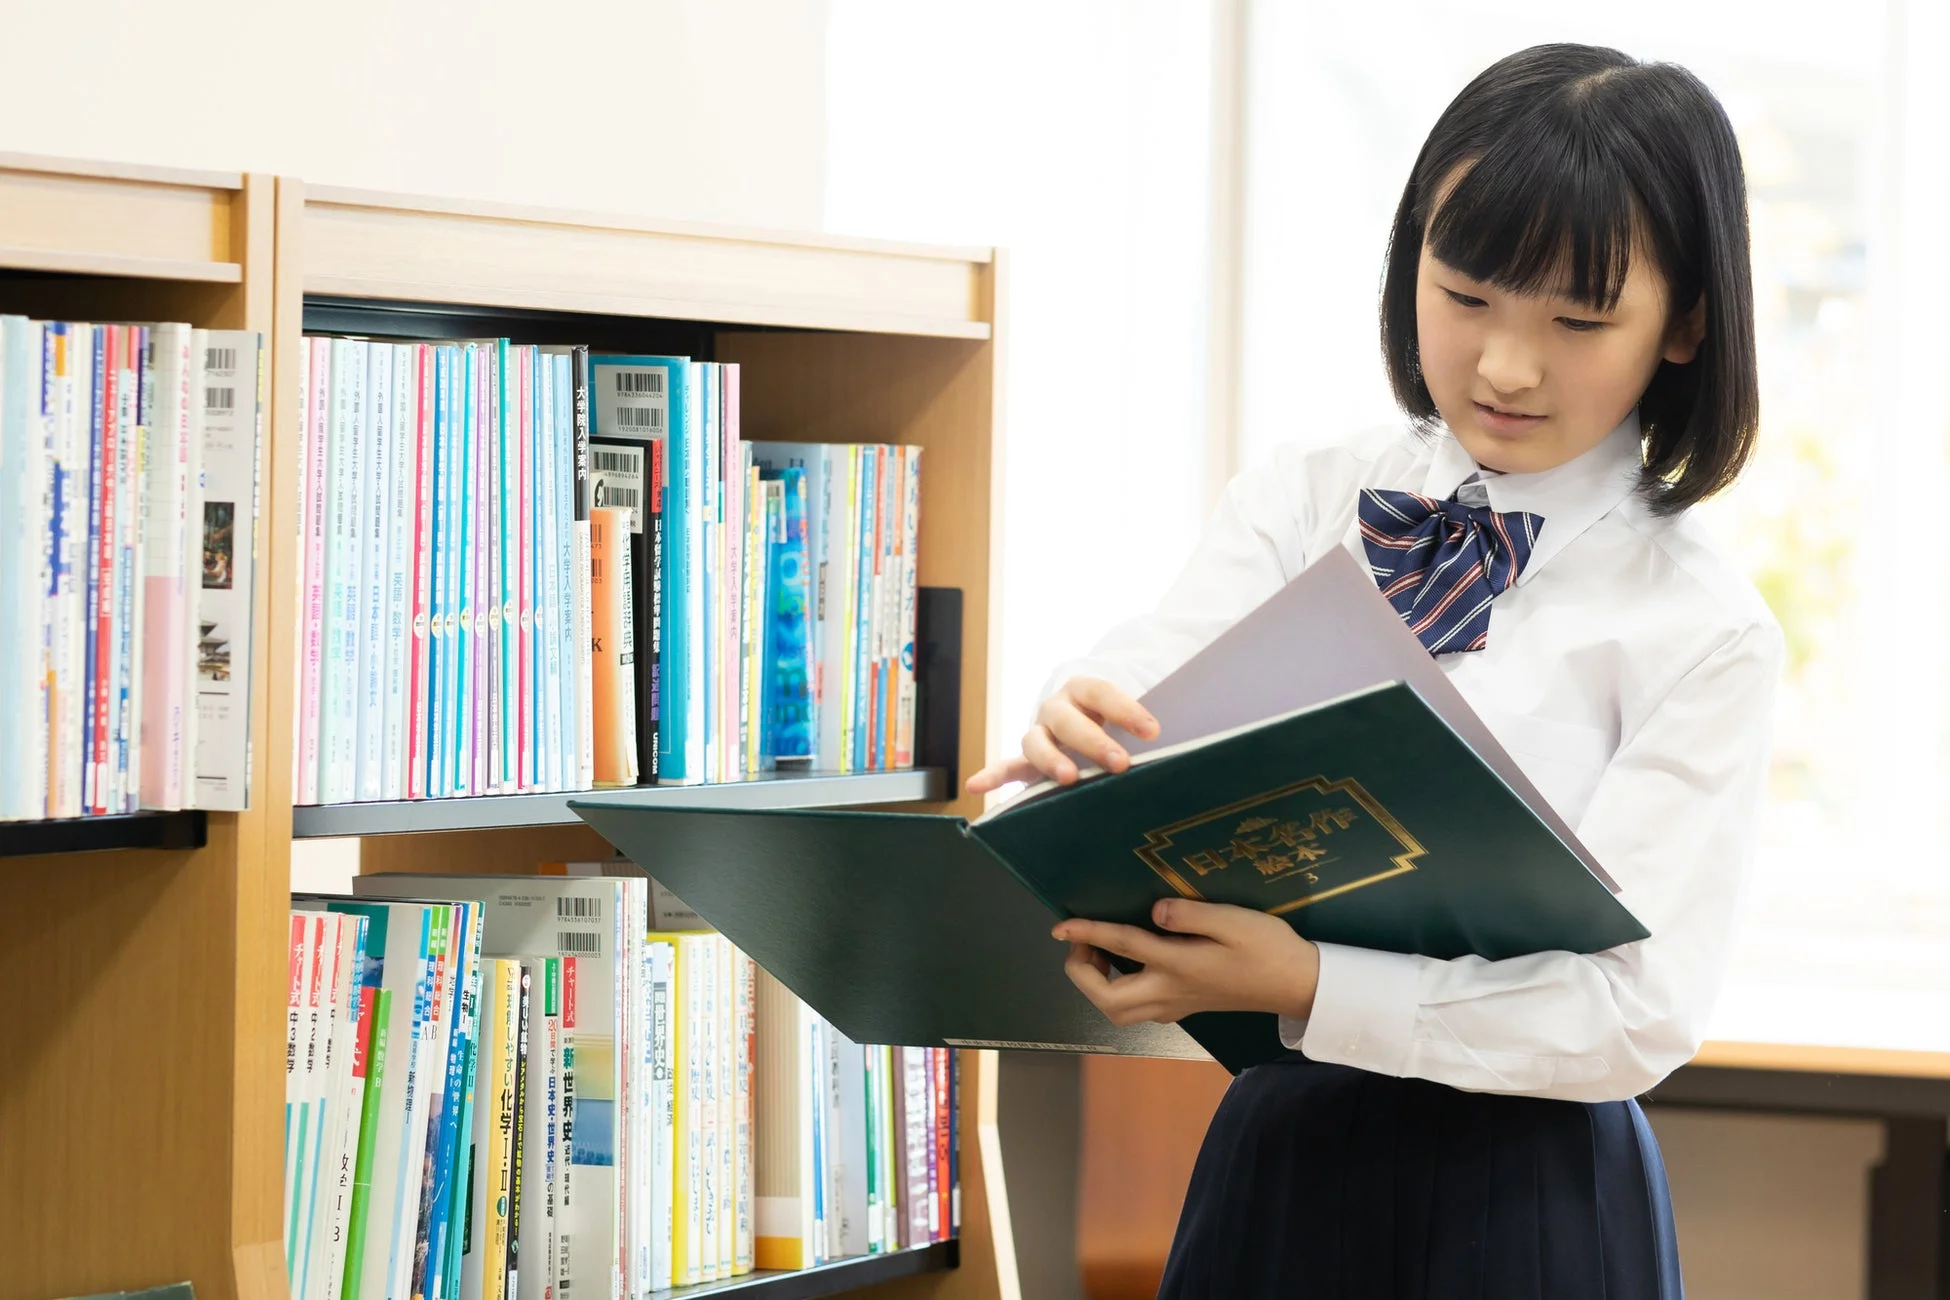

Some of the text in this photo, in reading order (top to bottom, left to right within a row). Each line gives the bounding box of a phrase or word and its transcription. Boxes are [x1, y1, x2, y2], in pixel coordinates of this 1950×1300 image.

[576, 386, 588, 481] 大学院入学案内
[651, 732, 659, 775] UNICOM
[1182, 808, 1359, 876] 日本名作
[1253, 842, 1328, 876] 絵本
[1304, 872, 1319, 884] 3
[423, 961, 436, 1017] 理科総合
[432, 961, 445, 1016] 理科総合
[566, 966, 575, 1023] チャート式
[562, 1047, 575, 1142] 新世界史
